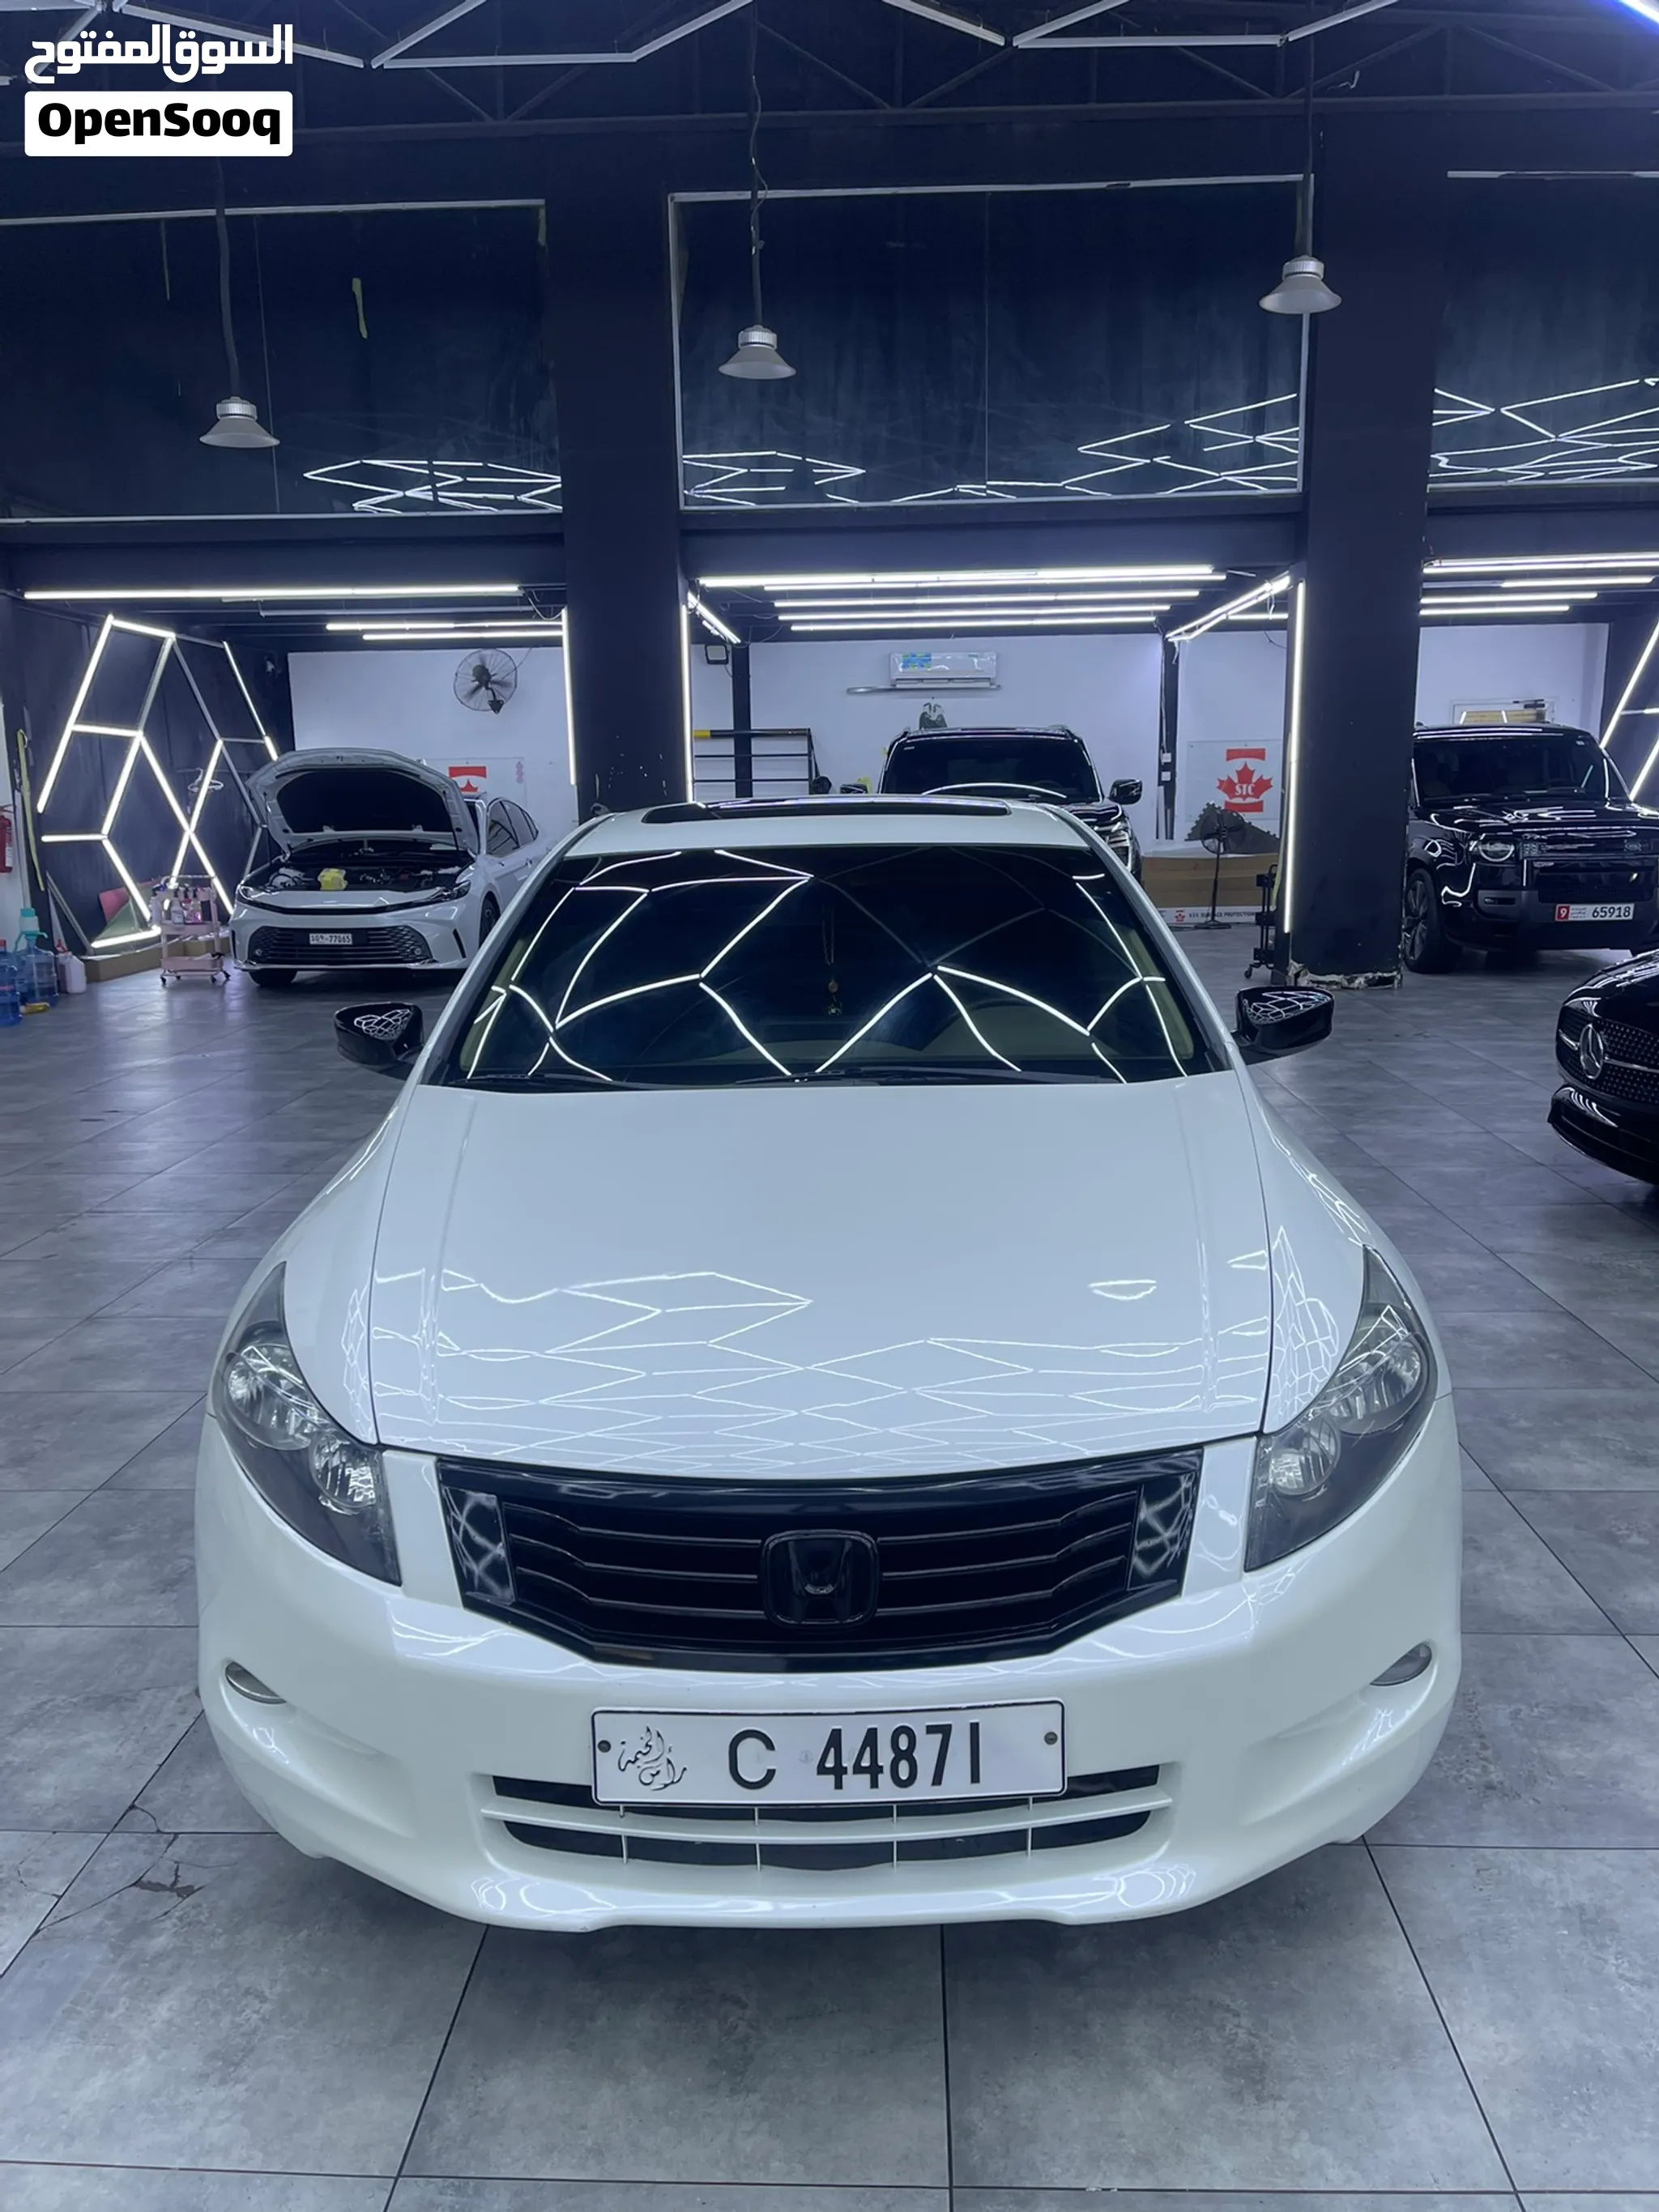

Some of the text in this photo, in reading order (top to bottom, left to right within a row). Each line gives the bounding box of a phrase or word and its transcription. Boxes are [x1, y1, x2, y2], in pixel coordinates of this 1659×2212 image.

[1235, 783, 1255, 795] STC
[1592, 906, 1631, 918] 65918
[729, 1722, 980, 1790] C 44871
